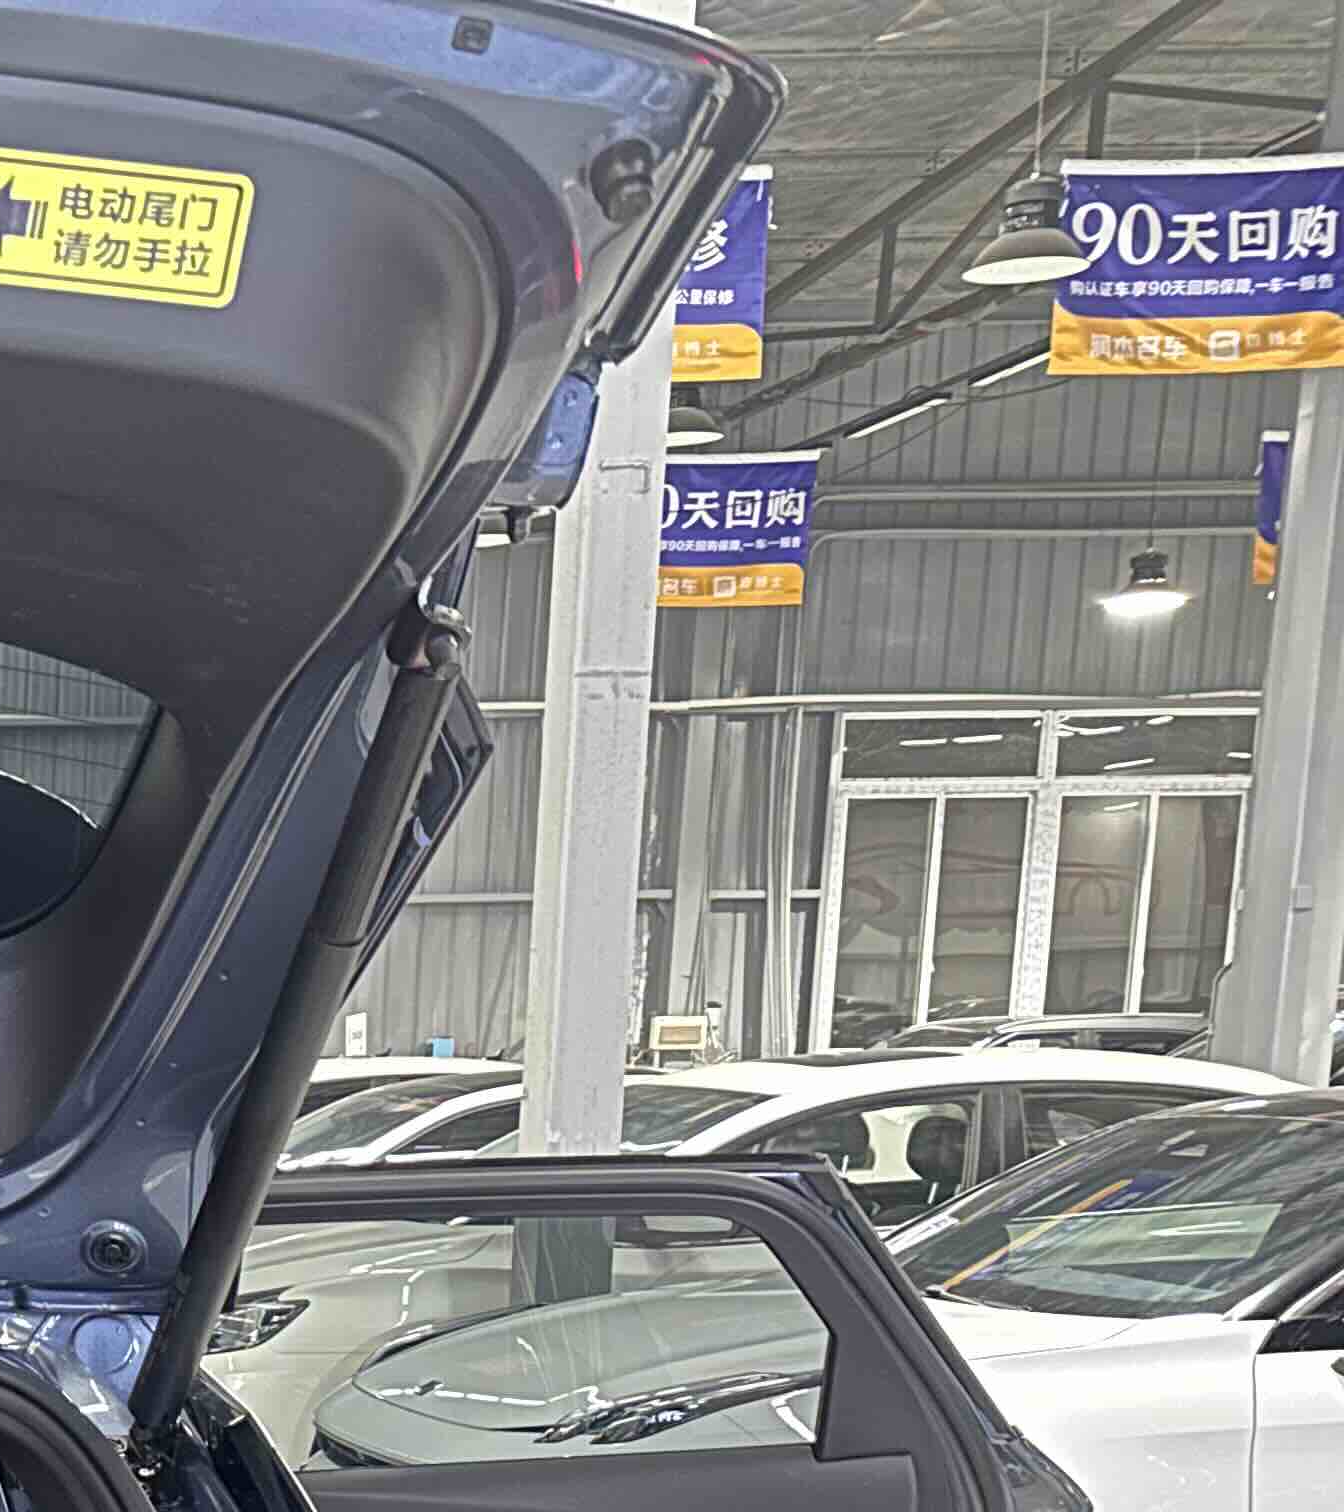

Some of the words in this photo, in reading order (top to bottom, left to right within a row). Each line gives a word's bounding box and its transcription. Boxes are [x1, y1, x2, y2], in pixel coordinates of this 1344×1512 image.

[58, 182, 219, 234] 电动尾门
[1071, 202, 1340, 266] 90天回购
[52, 228, 214, 278] 请勿手拉
